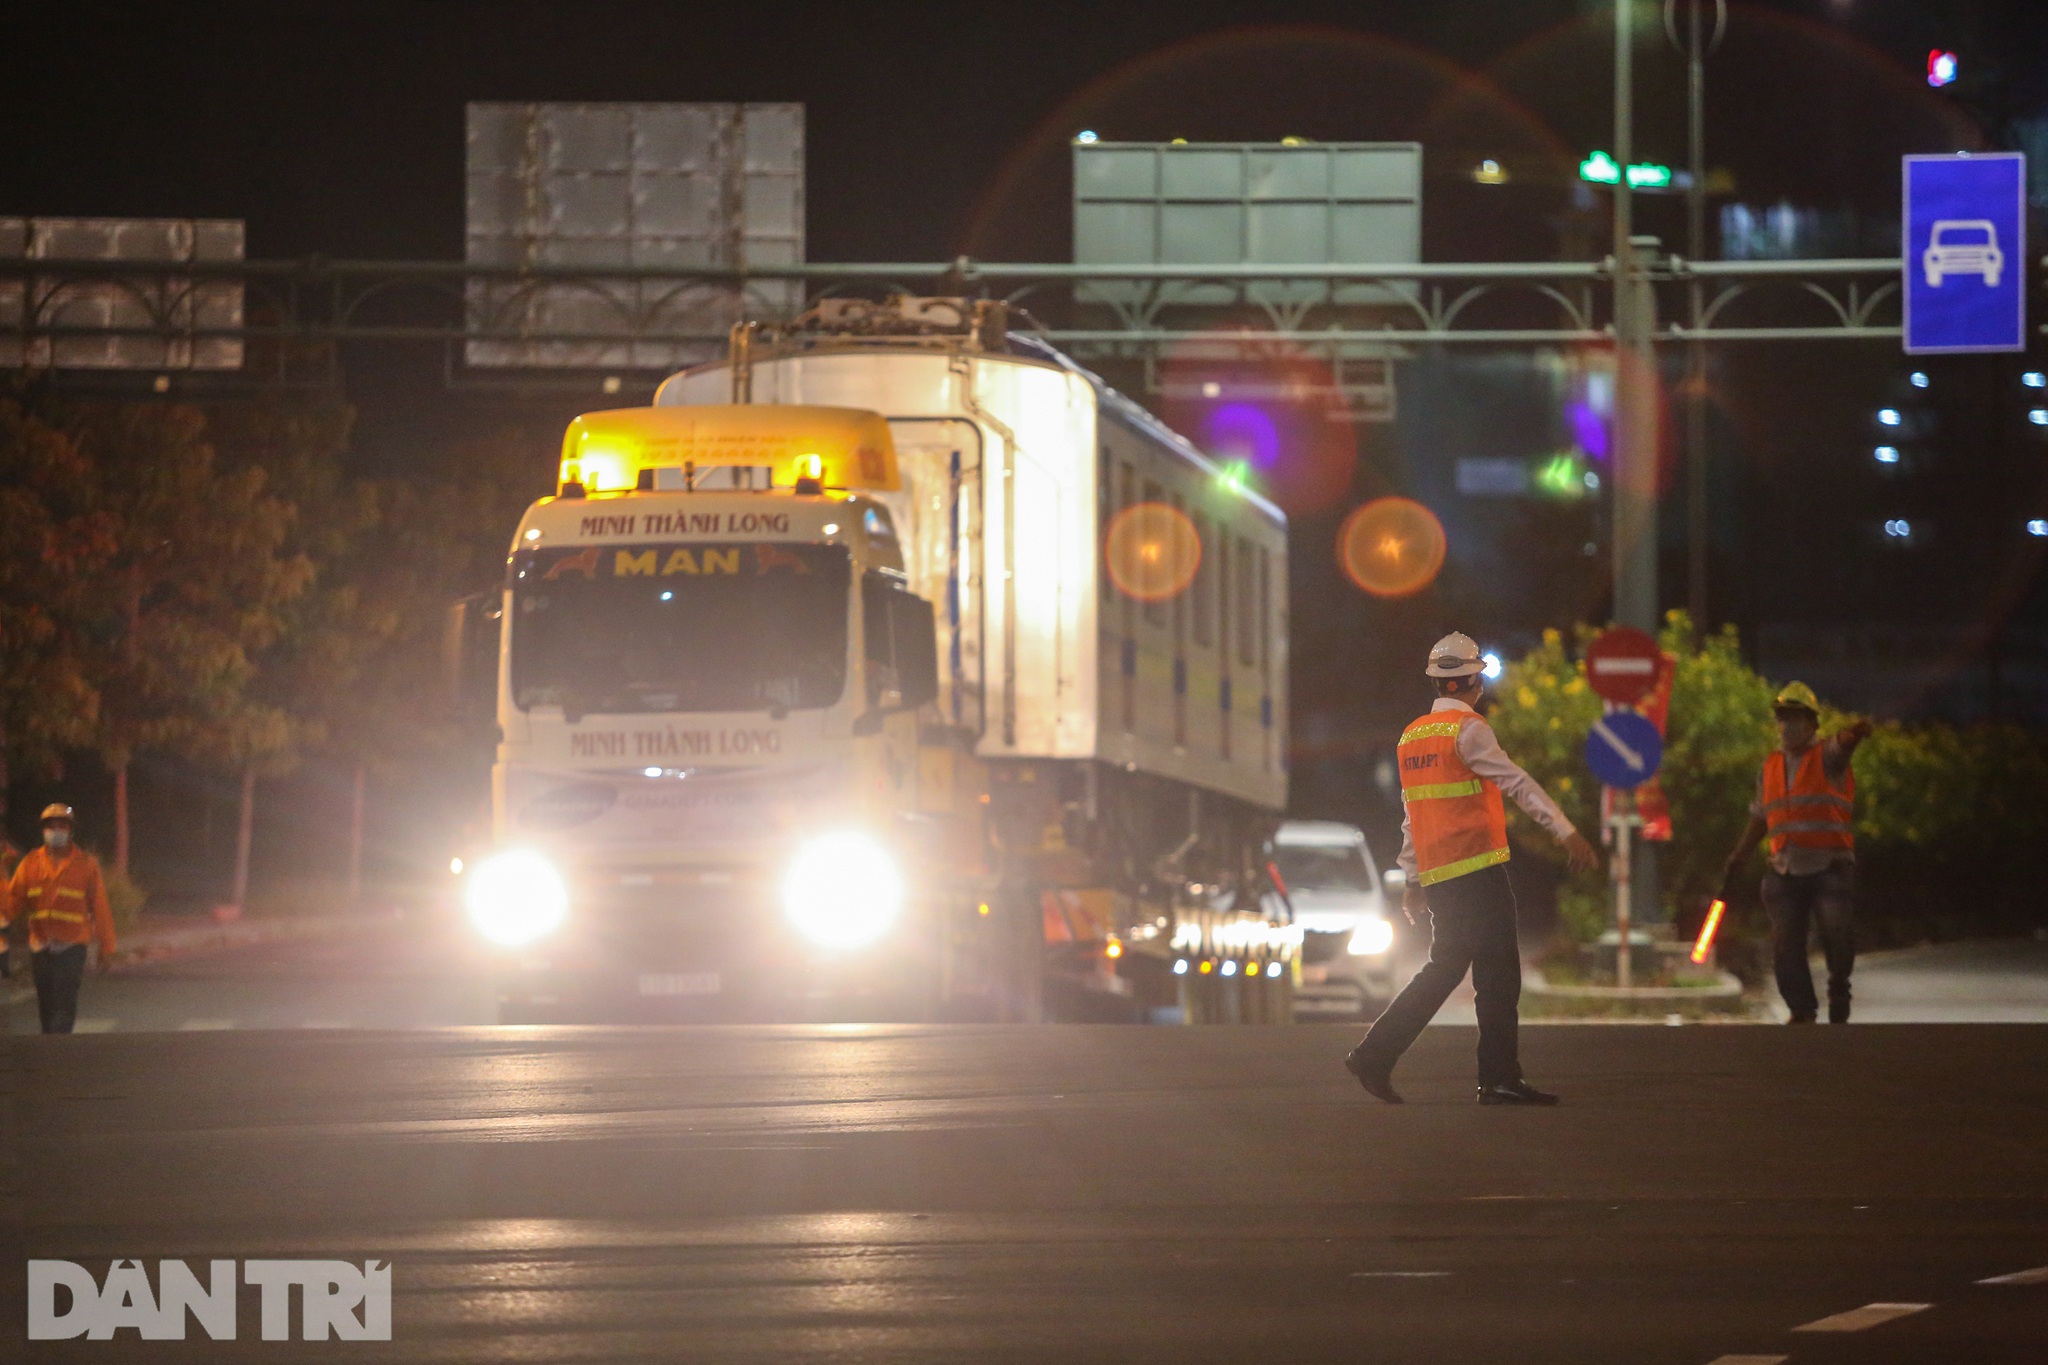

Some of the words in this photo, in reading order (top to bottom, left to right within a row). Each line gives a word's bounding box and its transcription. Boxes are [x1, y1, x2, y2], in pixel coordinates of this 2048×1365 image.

[580, 515, 636, 536] MINH
[643, 508, 720, 535] THÀNH
[727, 513, 790, 534] LONG
[615, 548, 741, 577] MAN
[570, 731, 627, 756] MINH
[633, 723, 712, 756] THÀNH
[718, 728, 782, 755] LONG
